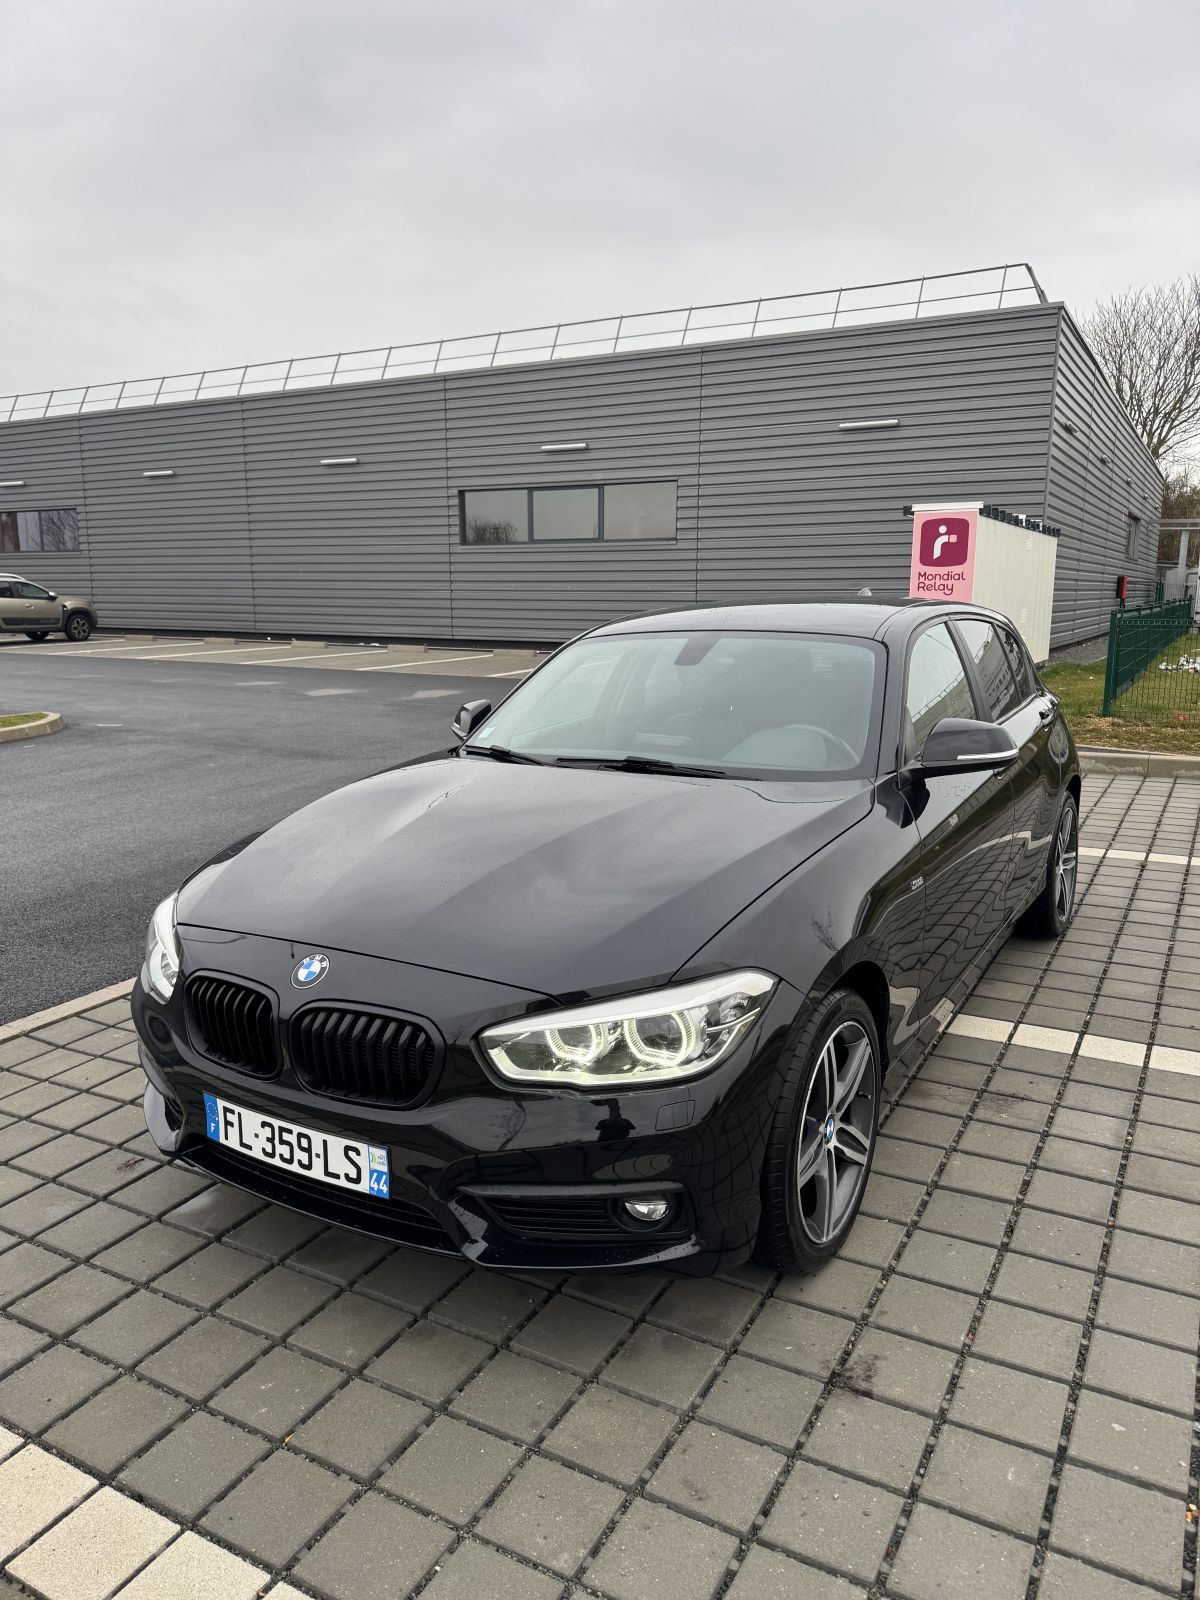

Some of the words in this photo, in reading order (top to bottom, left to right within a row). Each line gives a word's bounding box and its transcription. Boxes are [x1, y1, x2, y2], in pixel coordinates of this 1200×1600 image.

[917, 571, 966, 582] Mondial
[917, 581, 954, 596] Relay
[210, 1123, 216, 1134] F
[370, 1172, 388, 1194] 44
